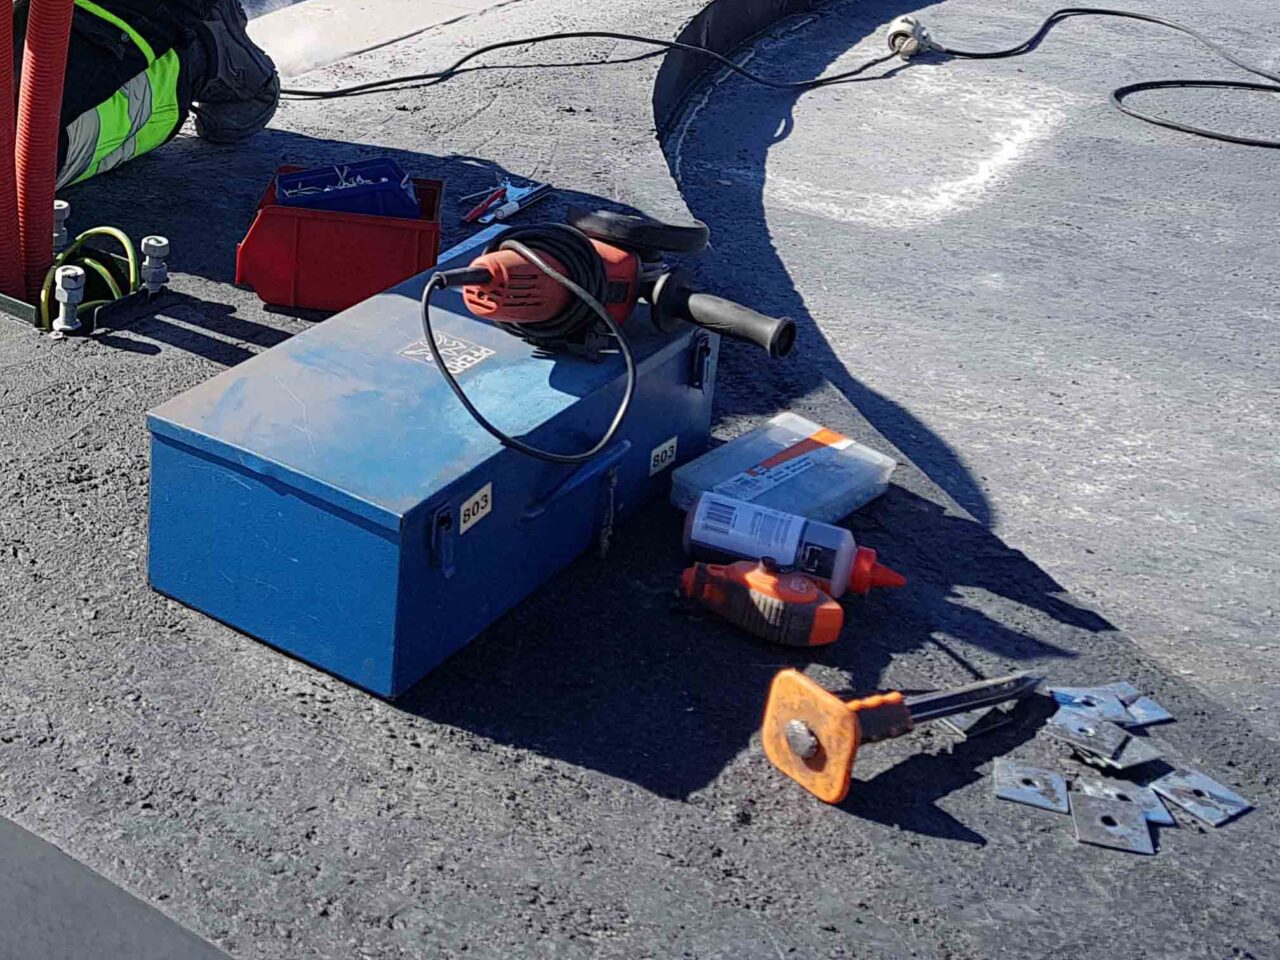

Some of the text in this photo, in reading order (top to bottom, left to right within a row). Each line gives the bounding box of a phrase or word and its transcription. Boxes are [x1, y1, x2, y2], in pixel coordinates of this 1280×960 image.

[446, 346, 496, 375] PFERD
[652, 445, 675, 468] 803
[462, 493, 489, 524] 803
